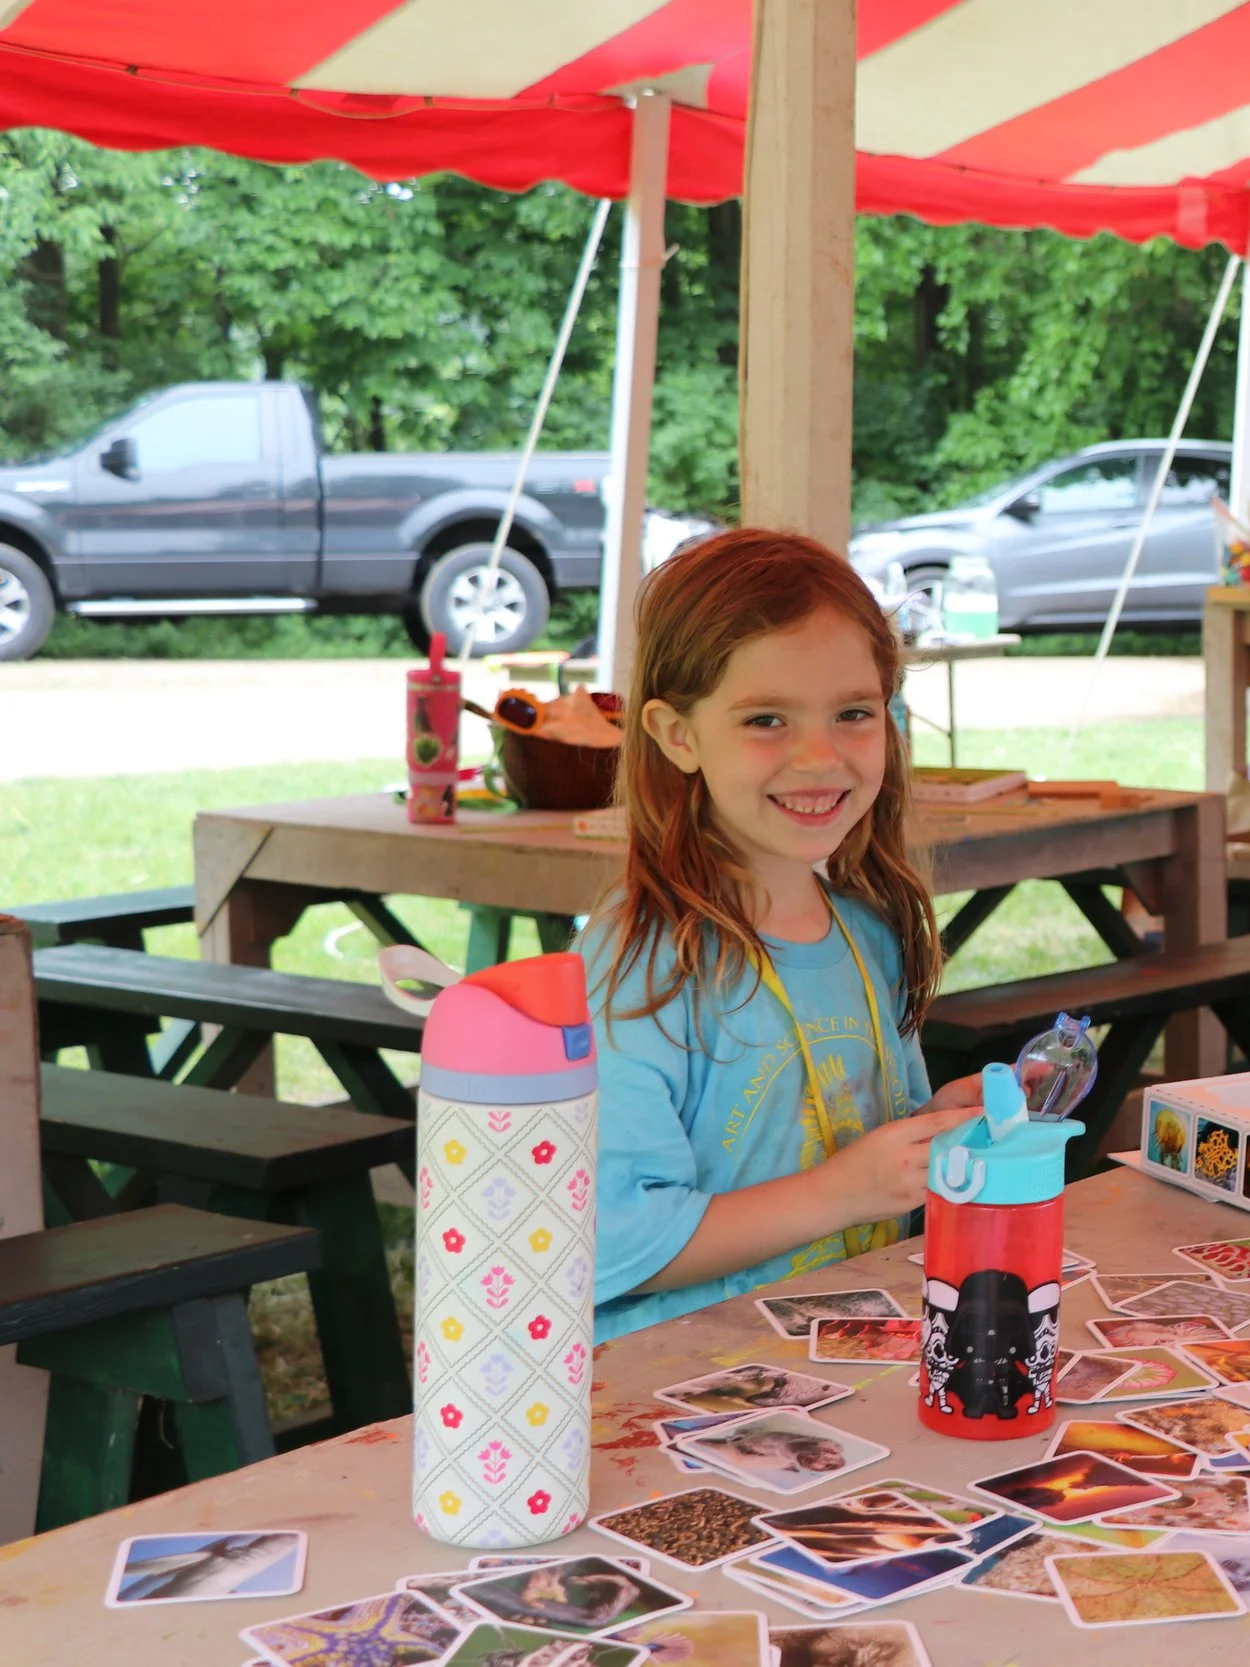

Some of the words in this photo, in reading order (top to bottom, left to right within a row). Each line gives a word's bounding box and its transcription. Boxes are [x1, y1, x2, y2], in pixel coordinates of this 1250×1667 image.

[721, 1103, 746, 1153] ART
[743, 1053, 776, 1103] AND
[775, 1015, 841, 1057] SCNCE
